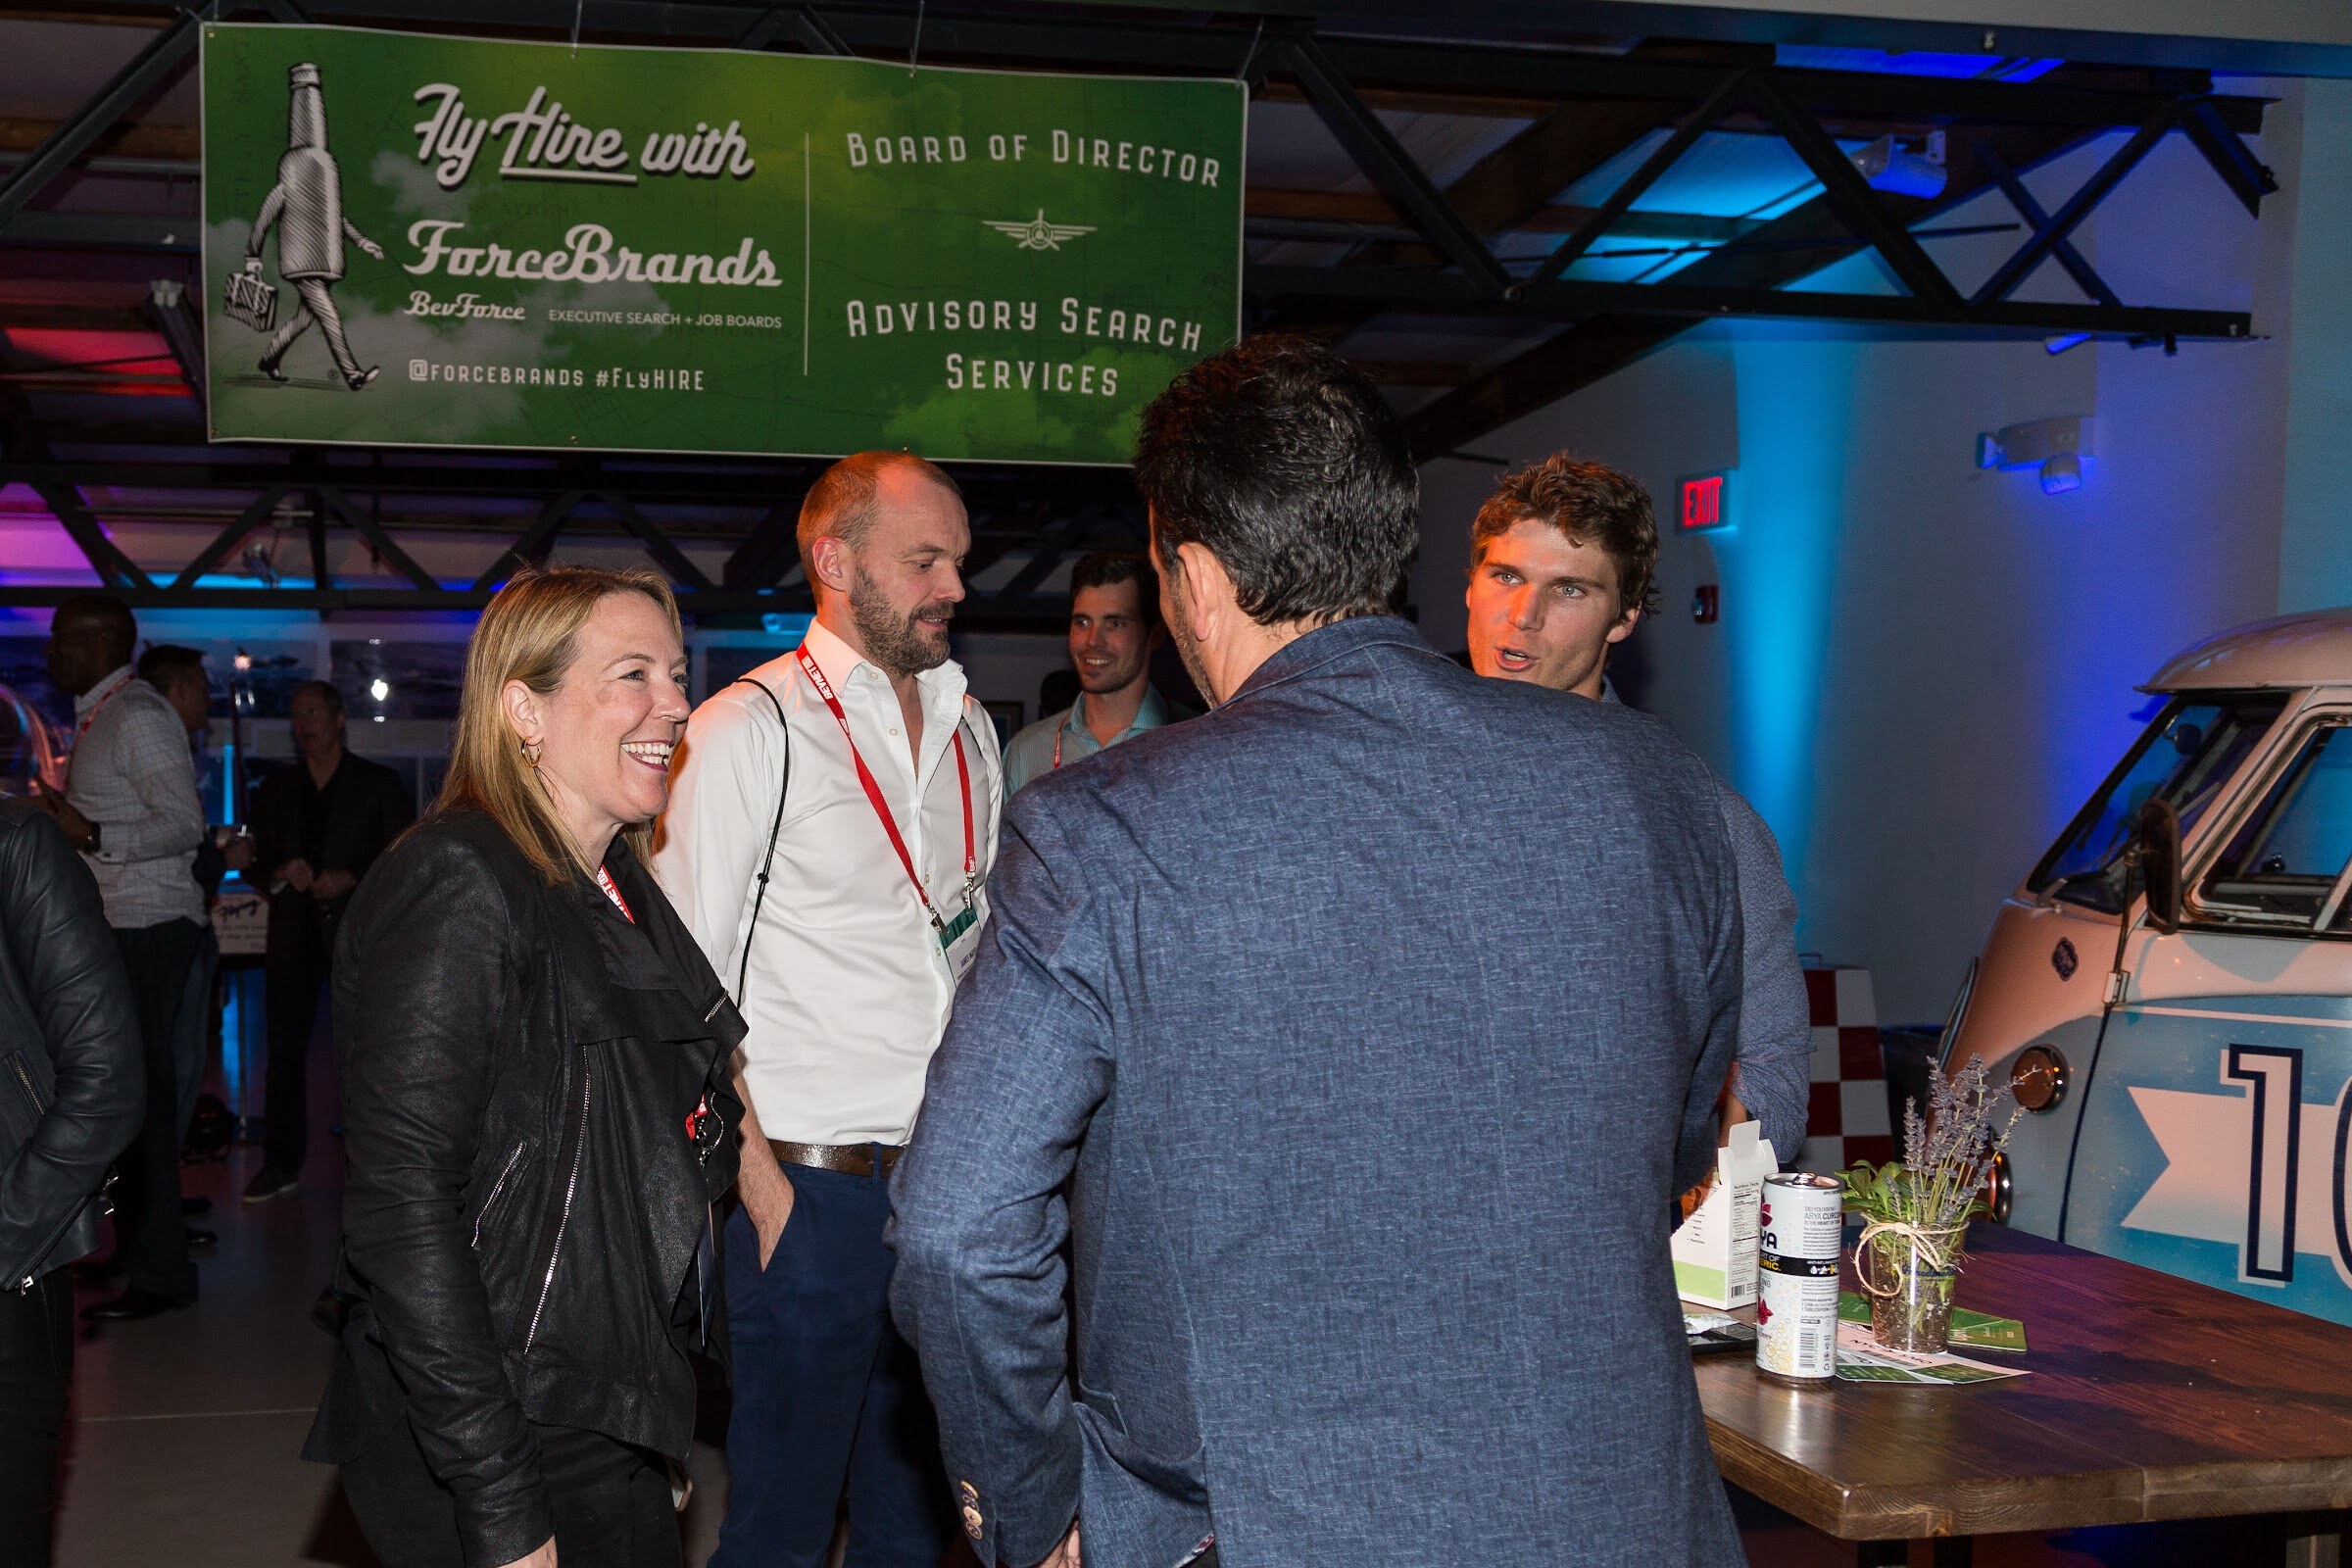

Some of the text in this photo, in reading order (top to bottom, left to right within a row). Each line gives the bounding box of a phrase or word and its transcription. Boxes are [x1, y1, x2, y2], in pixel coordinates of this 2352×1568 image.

[414, 83, 755, 186] Fly Hire with
[847, 128, 1221, 187] BOARD OF DIRECTOR
[403, 220, 783, 287] ForceBrands
[403, 291, 526, 320] BevForce
[549, 310, 623, 324] EXECUTIVE
[627, 311, 681, 325] SEARCH
[696, 315, 723, 326] JOB
[726, 315, 782, 328] BOARDS
[847, 297, 1202, 353] ADVISORY SEARCH
[947, 353, 1118, 397] SERVICES
[1683, 476, 1723, 527] EXIT
[807, 666, 834, 700] BEVNET
[2228, 1043, 2352, 1283] 1
